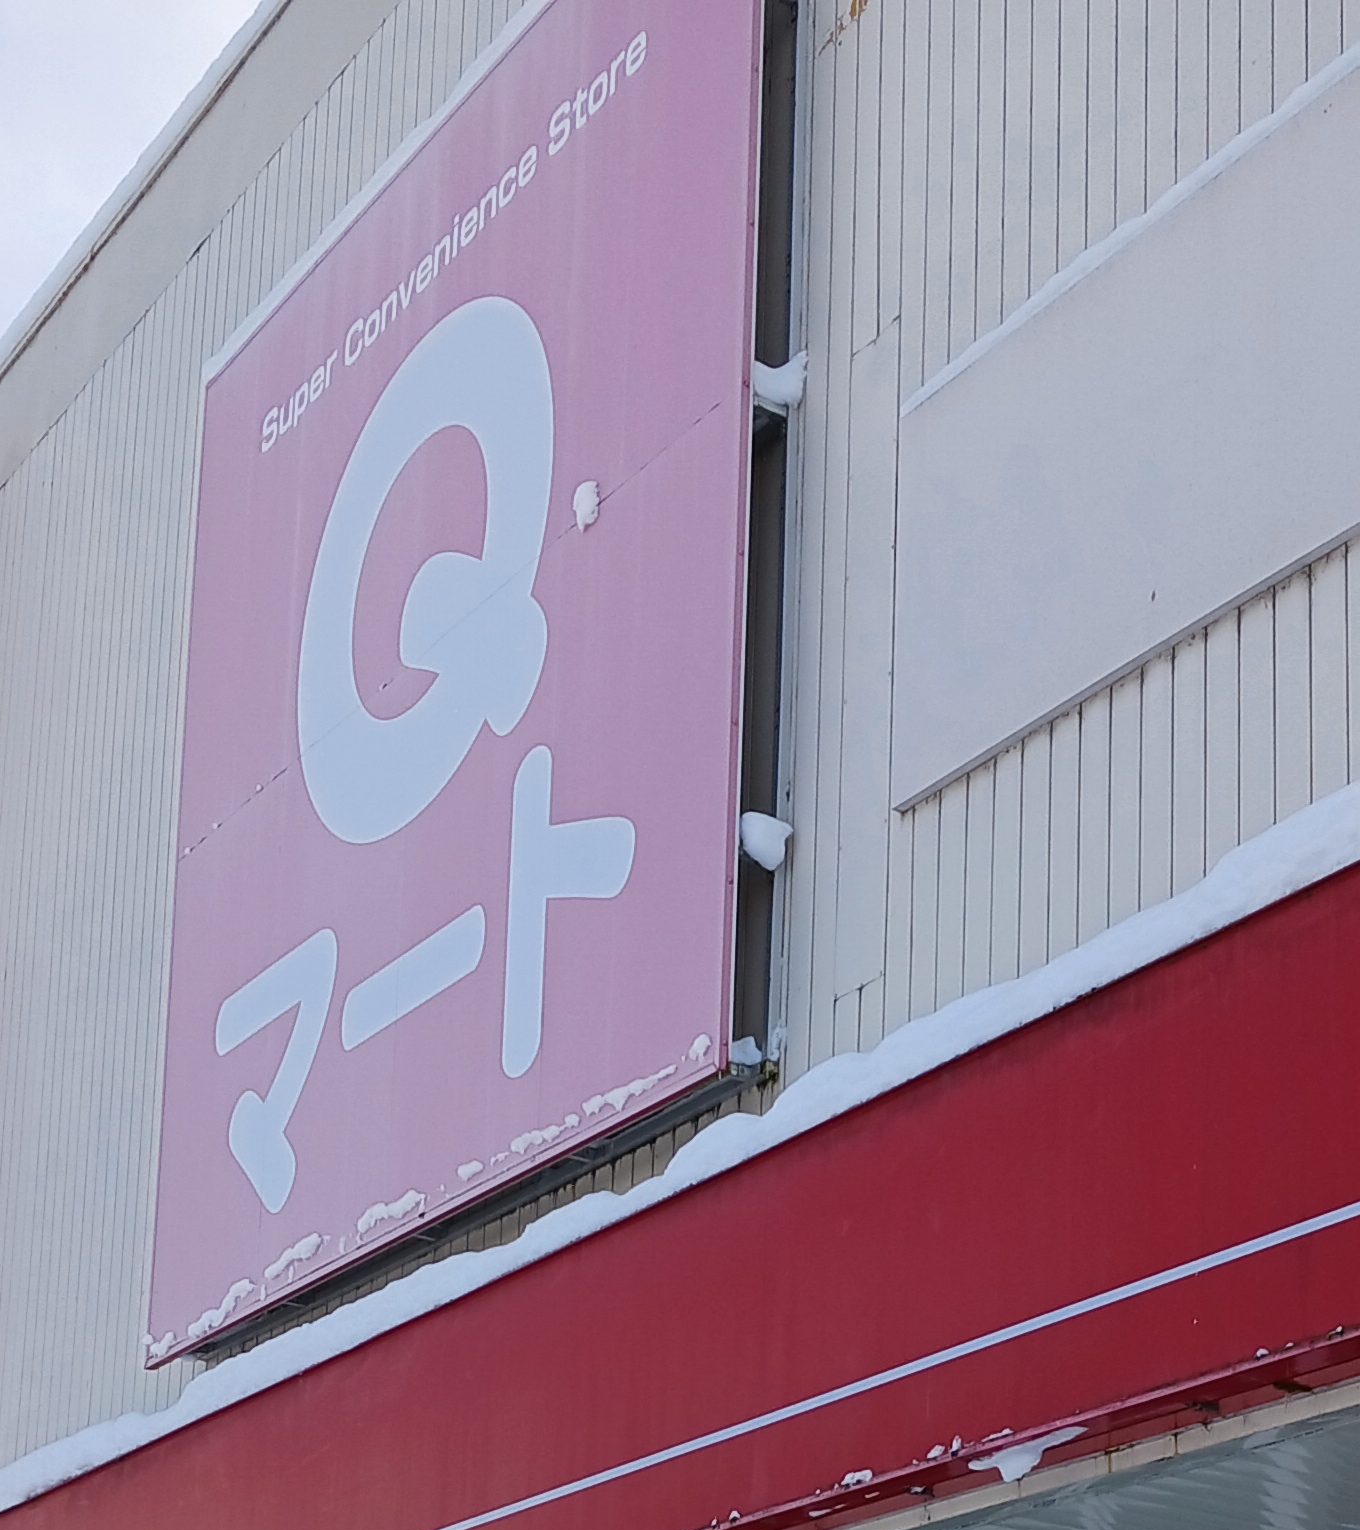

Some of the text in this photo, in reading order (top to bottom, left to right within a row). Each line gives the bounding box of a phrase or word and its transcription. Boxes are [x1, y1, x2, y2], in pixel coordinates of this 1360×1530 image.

[259, 30, 648, 455] Super Convenience Store
[215, 745, 636, 1214] マート
